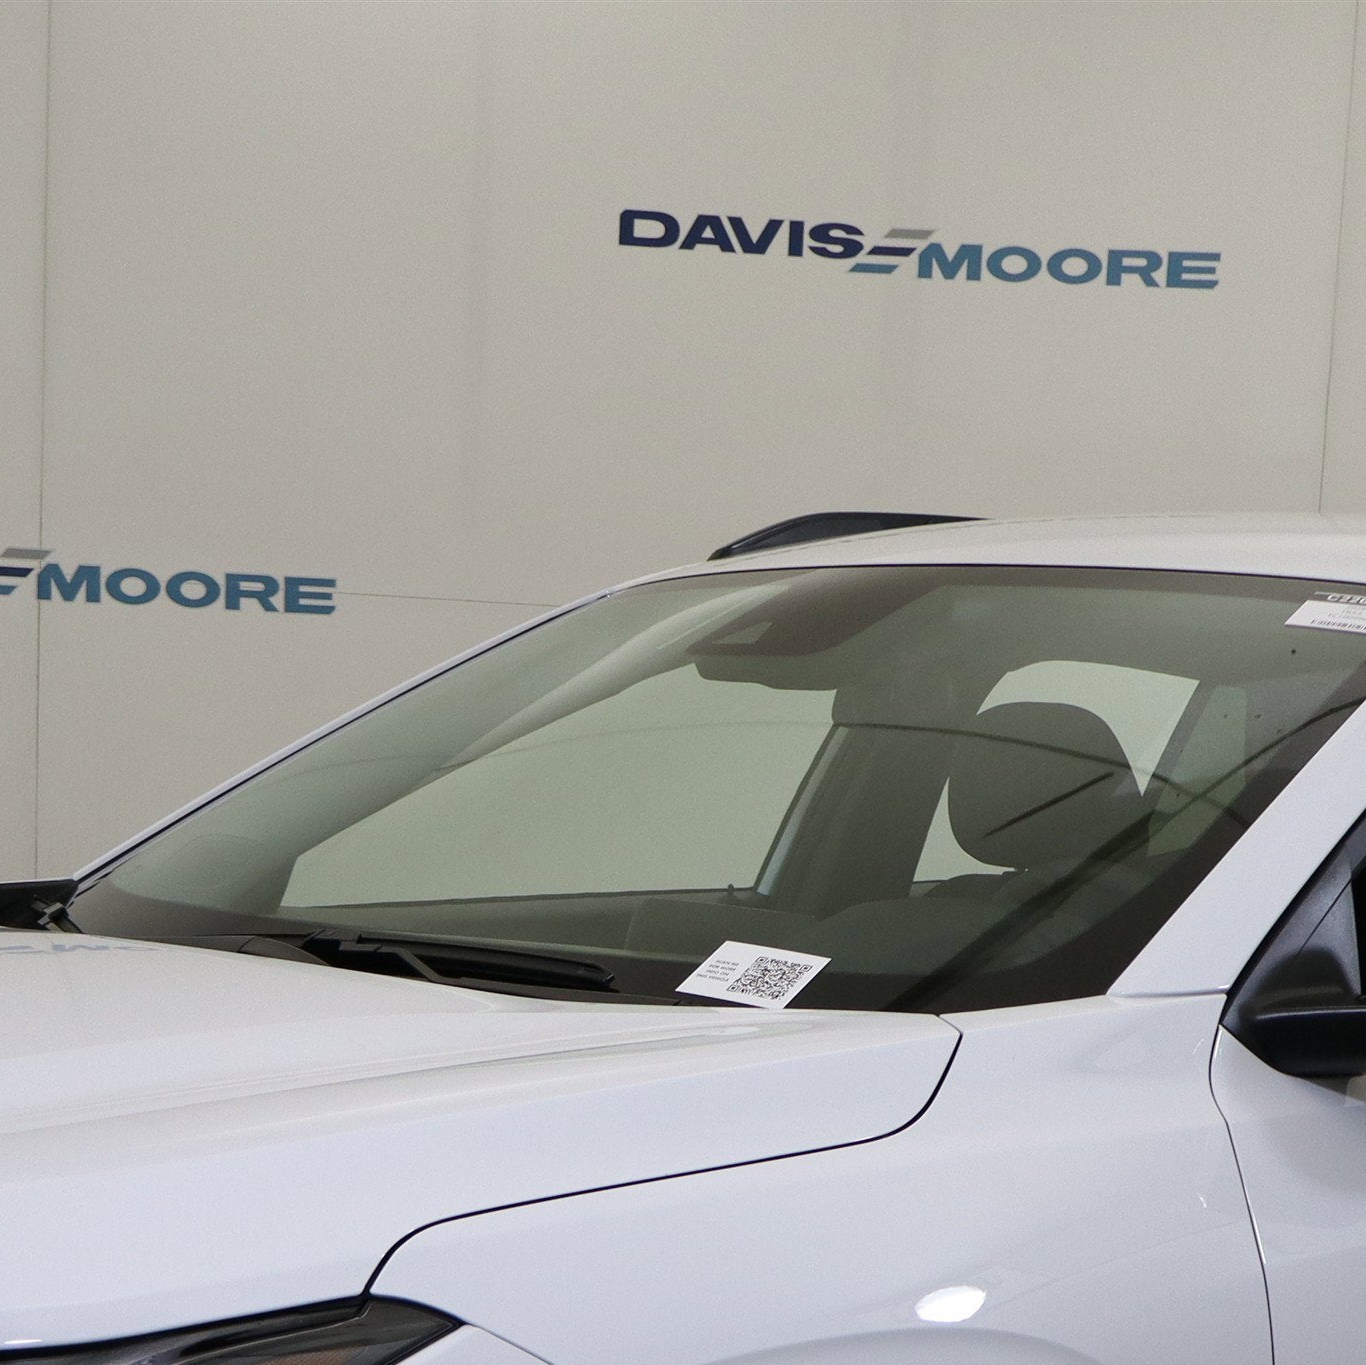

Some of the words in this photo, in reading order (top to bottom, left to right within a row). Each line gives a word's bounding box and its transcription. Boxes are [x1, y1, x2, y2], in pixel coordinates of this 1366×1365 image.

[618, 209, 866, 260] DAVIS
[917, 243, 1221, 290] MOORE
[36, 563, 336, 615] MOORE
